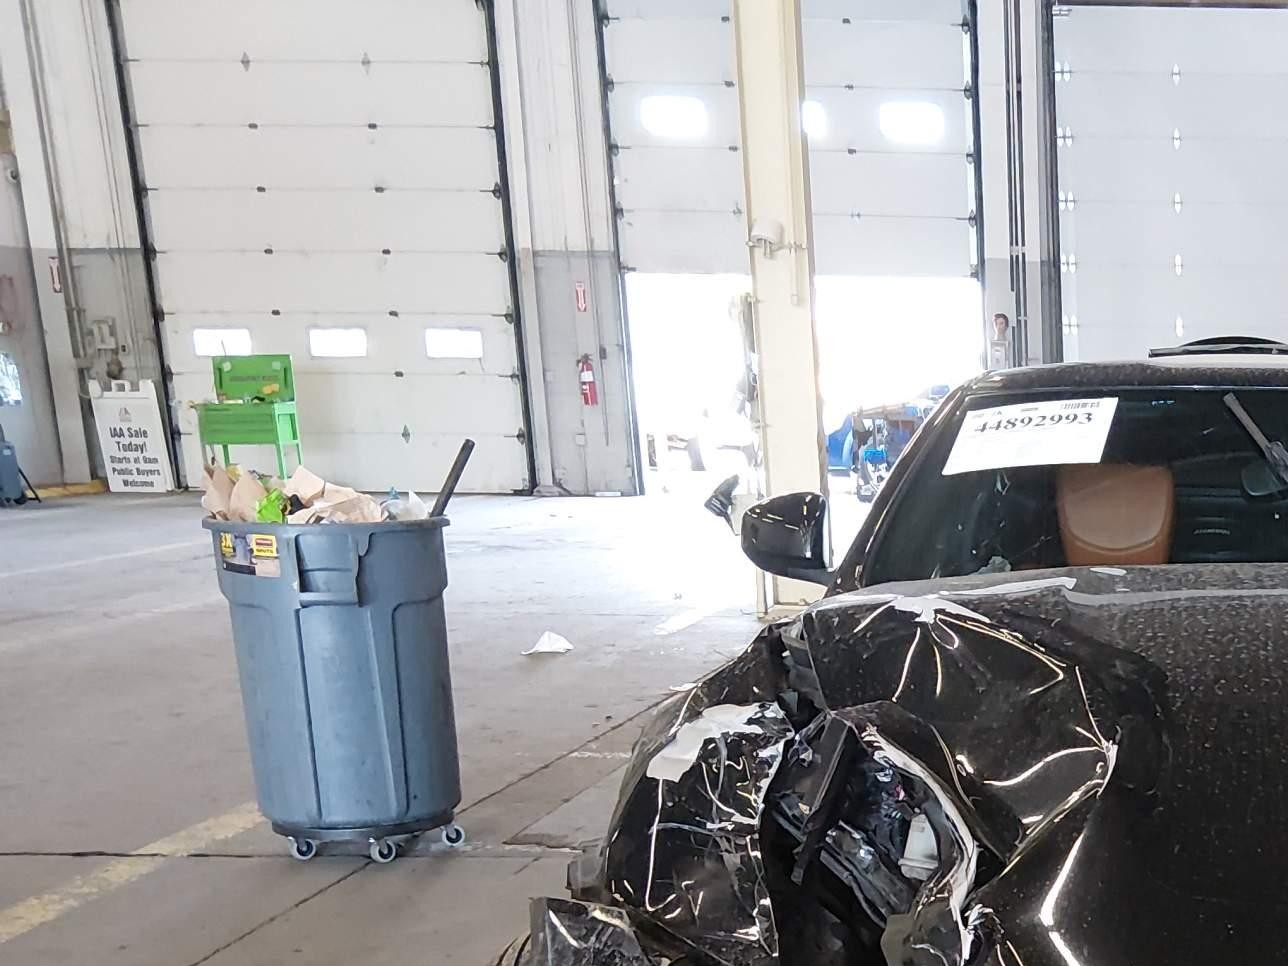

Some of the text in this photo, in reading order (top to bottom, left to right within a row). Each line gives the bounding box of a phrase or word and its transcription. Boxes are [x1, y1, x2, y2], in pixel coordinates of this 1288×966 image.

[974, 412, 1093, 433] 44892993
[109, 426, 149, 439] IAA Sale
[115, 441, 148, 454] Today!
[110, 455, 131, 464] Starts
[133, 456, 141, 464] at
[112, 467, 161, 478] Public Buyers
[122, 479, 155, 487] Welcome
